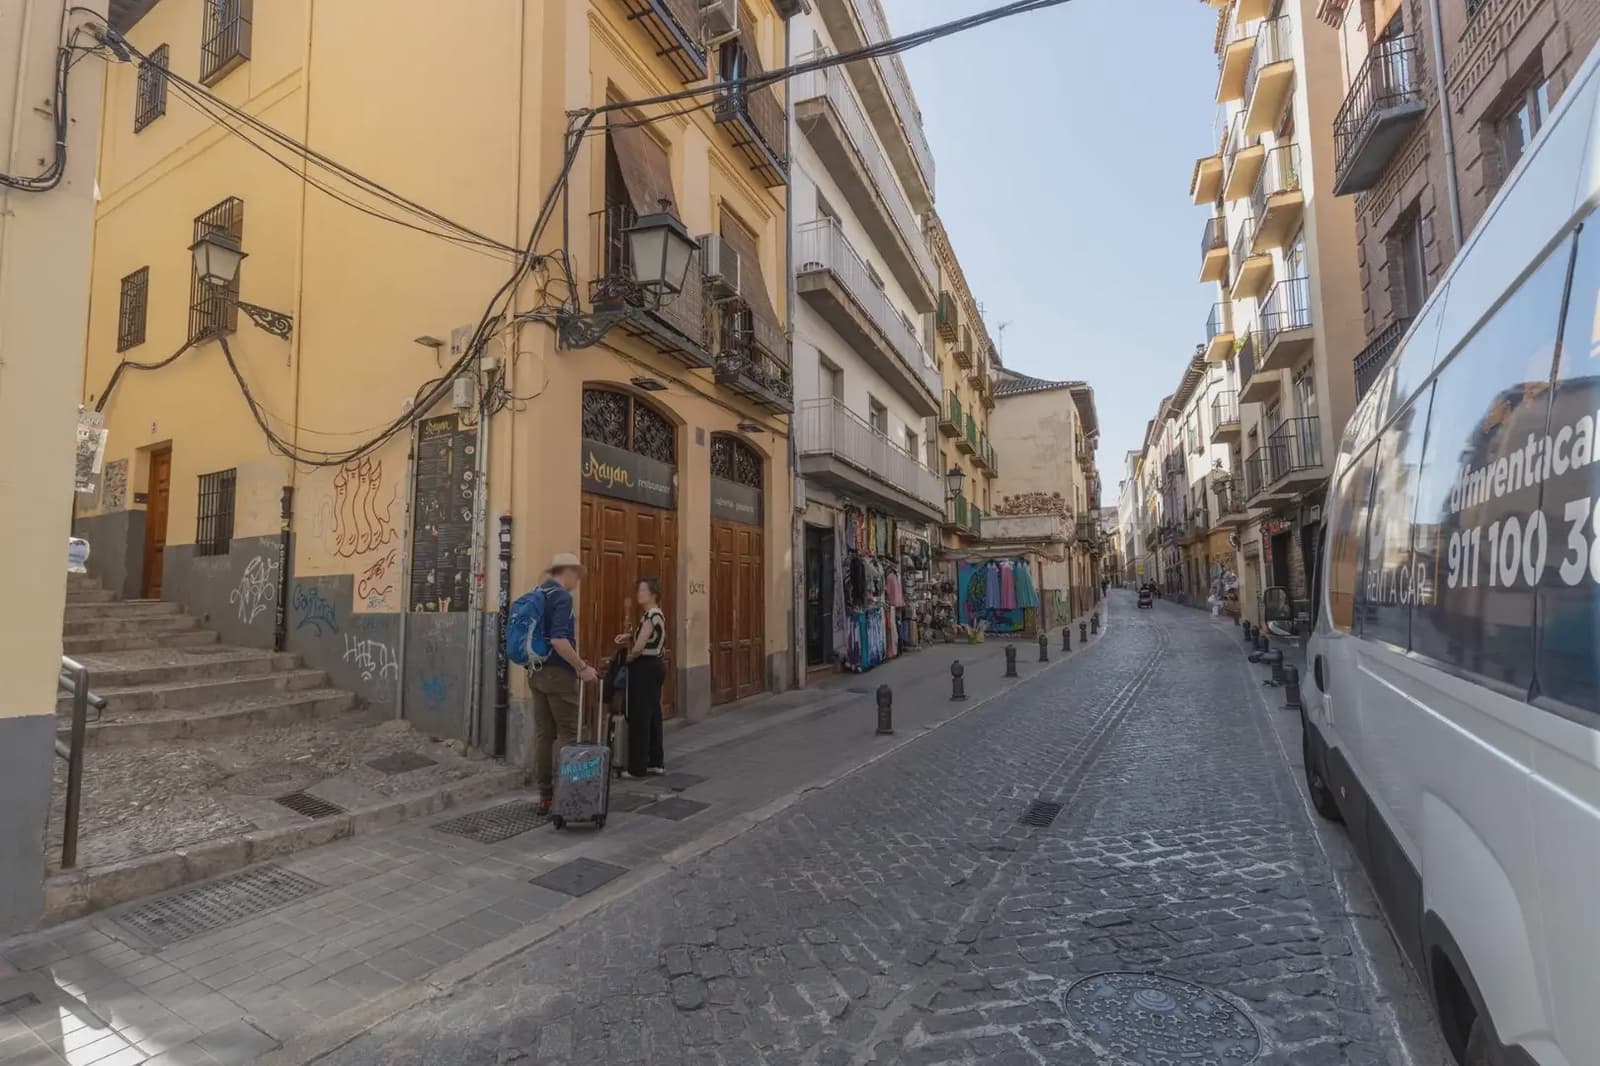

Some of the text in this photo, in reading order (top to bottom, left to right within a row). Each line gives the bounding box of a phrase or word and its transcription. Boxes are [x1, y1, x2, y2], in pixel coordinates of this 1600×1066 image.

[582, 451, 634, 488] Rayan
[1448, 526, 1480, 588] 911
[1489, 510, 1548, 588] 100
[1366, 562, 1426, 606] RENT A CAR
